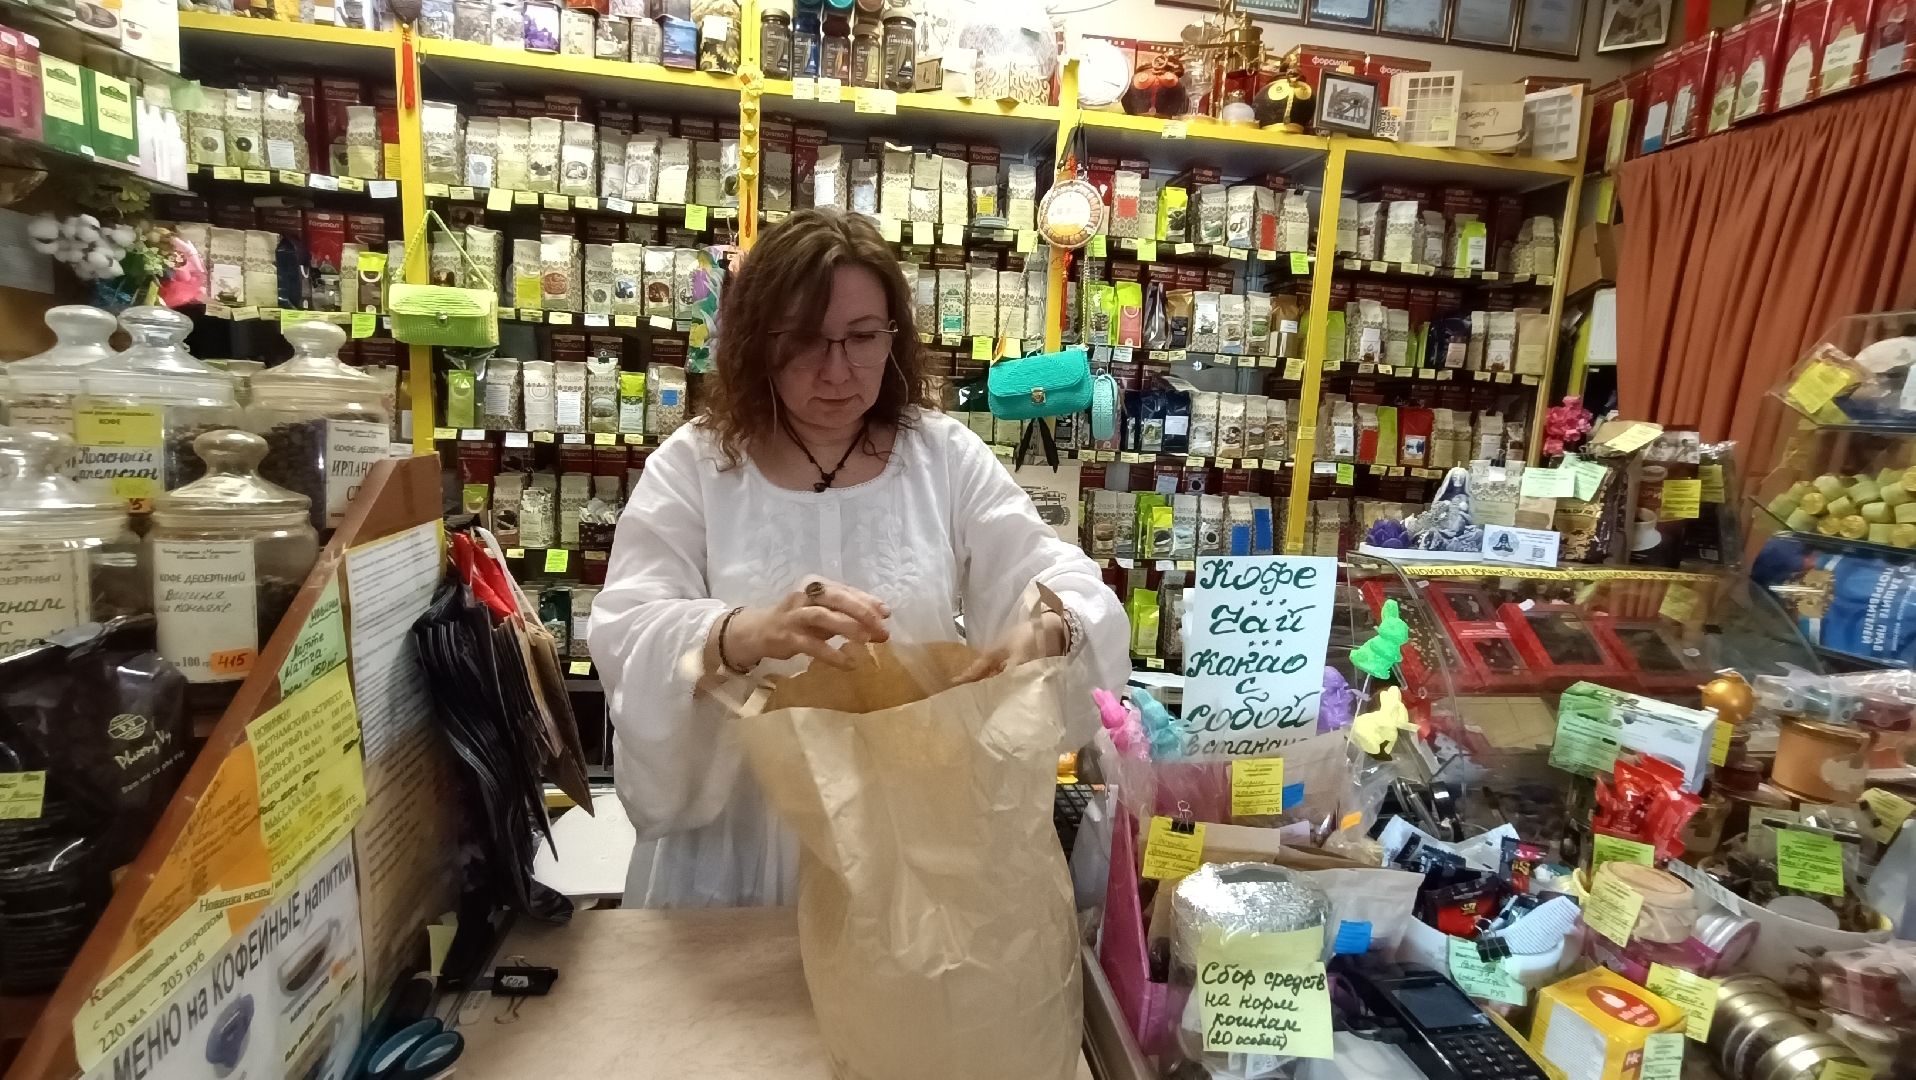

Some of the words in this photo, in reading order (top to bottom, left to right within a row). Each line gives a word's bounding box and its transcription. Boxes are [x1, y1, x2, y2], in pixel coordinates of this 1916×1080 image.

[333, 444, 356, 453] КОФЕ
[160, 573, 182, 583] КОФЕ
[184, 571, 247, 585] ДЕСЕРТНЫЙ
[1200, 558, 1317, 595] Кофе
[1209, 604, 1317, 635] Чай
[1861, 567, 1895, 644] ПОТРЕБИТЕЛЕЙ
[1873, 624, 1888, 651] ПРАВ
[217, 652, 249, 669] 415
[1186, 649, 1308, 678] Какао
[304, 854, 352, 918] напитки
[201, 893, 242, 913] Новинка
[179, 911, 225, 953] сиропом
[113, 1003, 182, 1080] МЕНЮ
[186, 987, 209, 1032] на
[212, 890, 300, 1007] КОФЕЙНЫЕ
[1201, 961, 1256, 992] Сбор
[1264, 972, 1326, 996] средств
[98, 1021, 126, 1054] 220
[161, 970, 184, 997] 205
[185, 949, 206, 976] руб
[1205, 991, 1232, 1008] на
[1213, 1013, 1301, 1033] кошкам
[1235, 1032, 1288, 1051] особей)
